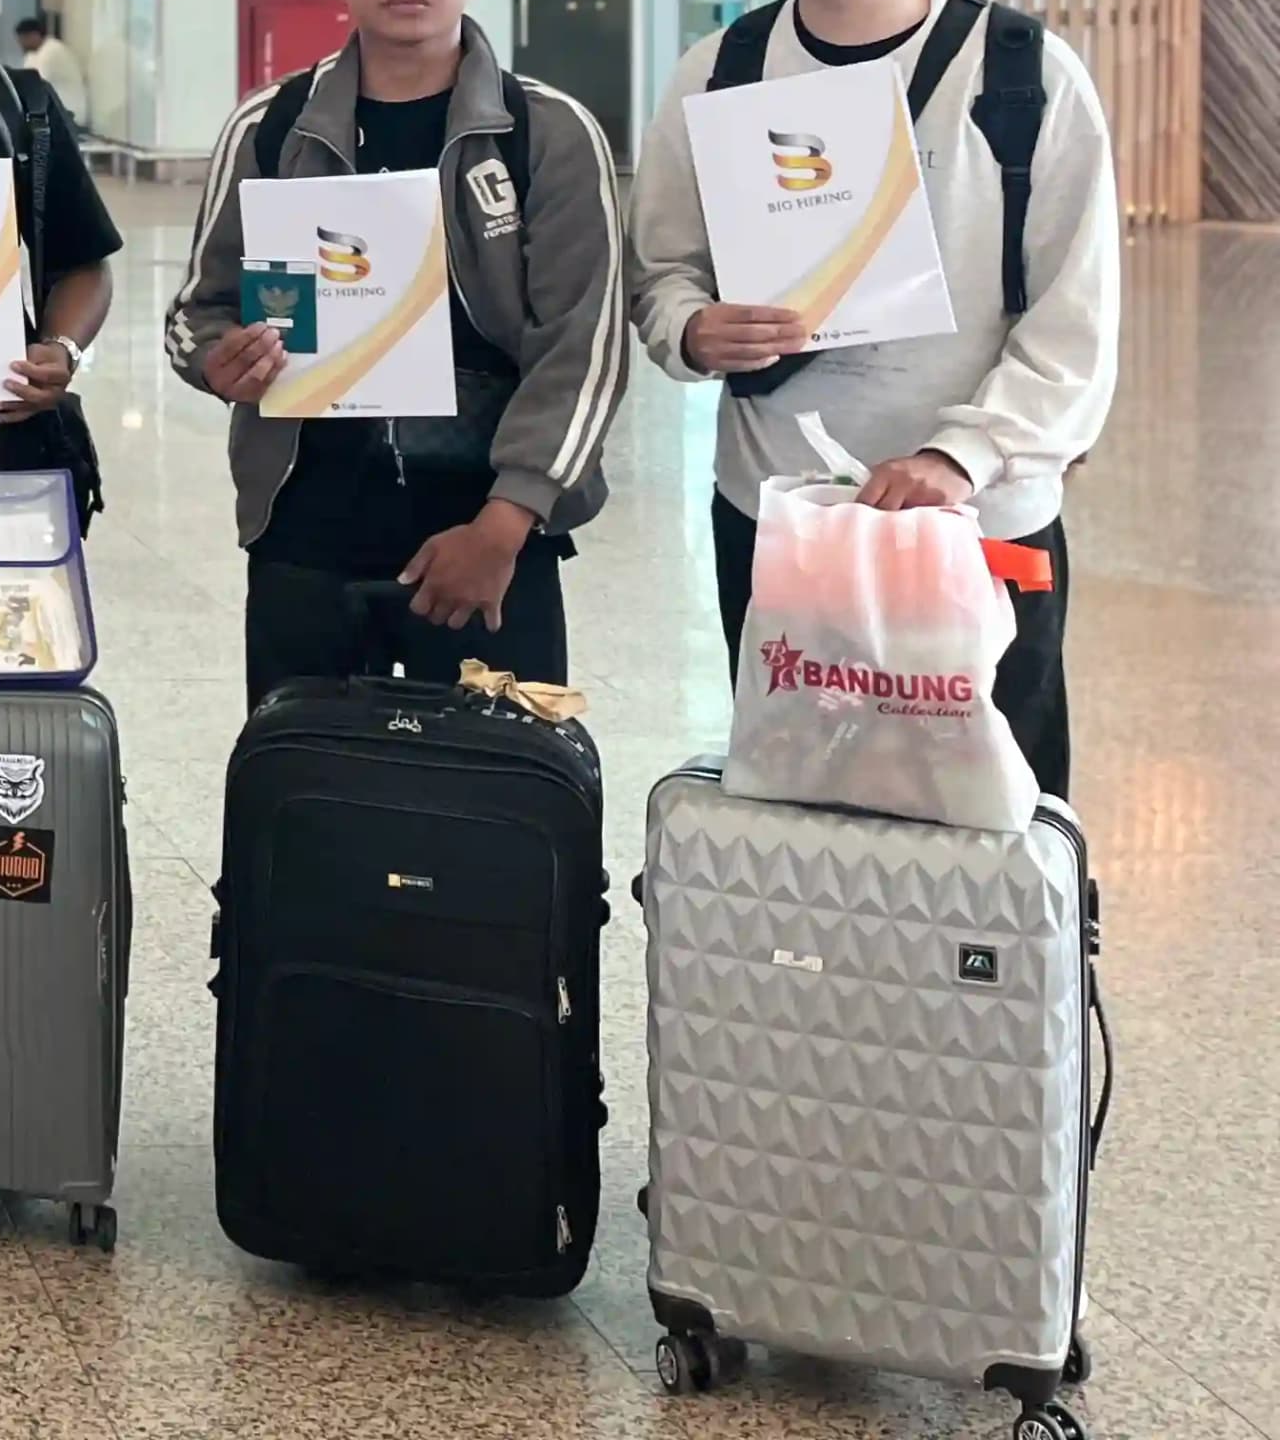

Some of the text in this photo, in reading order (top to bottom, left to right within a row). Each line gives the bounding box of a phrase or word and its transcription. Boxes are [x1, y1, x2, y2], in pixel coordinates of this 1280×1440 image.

[767, 189, 853, 214] BIG HIRING
[802, 659, 973, 703] BANDUNG
